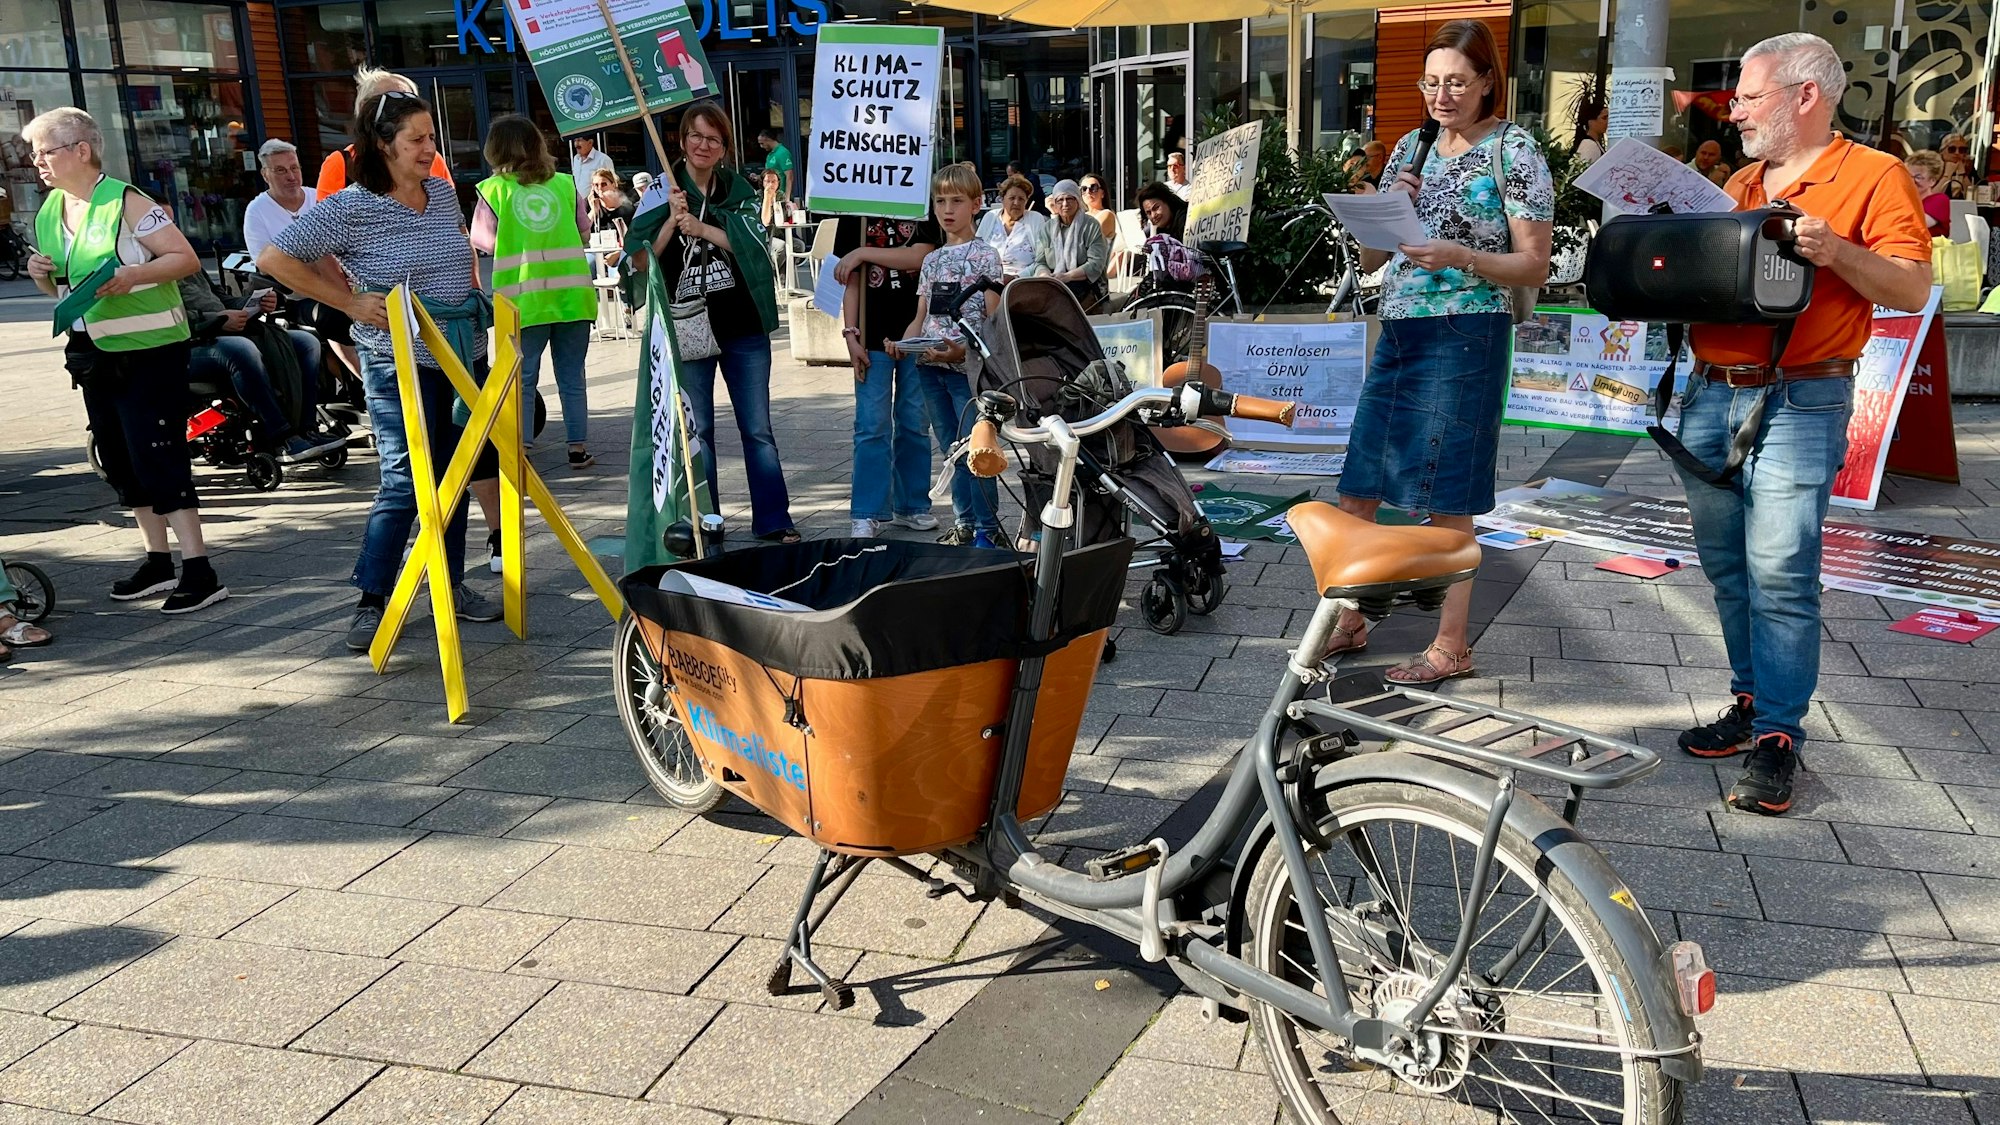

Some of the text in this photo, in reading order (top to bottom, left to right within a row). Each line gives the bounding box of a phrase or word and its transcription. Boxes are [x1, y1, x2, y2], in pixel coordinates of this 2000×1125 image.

[540, 3, 591, 20] Verkehrsplanung
[1635, 14, 1644, 27] 5
[539, 43, 568, 57] HÖCHSTE
[568, 32, 604, 48] EISENBAHN
[626, 11, 680, 31] VERKEHRSWENDE!
[557, 83, 570, 114] PARENTS
[570, 77, 597, 92] FUTURE
[831, 78, 921, 101] SCHUTZ
[574, 97, 601, 119] GERMANY
[853, 103, 894, 125] IST
[819, 130, 928, 156] MENSCHEN-
[1197, 125, 1258, 162] KLIMASCHUTZ
[822, 162, 914, 187] SCHUTZ
[1223, 206, 1249, 228] VER-
[1764, 254, 1797, 282] JBL
[1120, 344, 1138, 354] von
[1246, 344, 1330, 358] Kostenlosen
[1267, 364, 1309, 377] ÖPNV
[1515, 356, 1534, 364] UNSER
[1540, 359, 1562, 367] ALLTAG
[1591, 363, 1624, 373] NÄCHSTEN
[1649, 365, 1667, 373] JAHR
[1271, 386, 1304, 397] statt
[1511, 392, 1529, 400] WENN
[1593, 376, 1641, 403] Umleitung
[1296, 406, 1338, 419] chaos
[1507, 403, 1545, 413] MEGASTELZE
[1622, 418, 1655, 426] ZULASSEN
[1821, 554, 1917, 574] raßengesetz
[1919, 567, 1953, 579] auf
[1843, 549, 1875, 557] und
[1875, 552, 1979, 573] Fernstraßen
[1887, 574, 1920, 585] aus
[1922, 579, 1977, 593] einem
[668, 644, 737, 693] BABBOE City
[687, 698, 807, 791] Klimaliste
[1568, 906, 1612, 973] SCHWALBE
